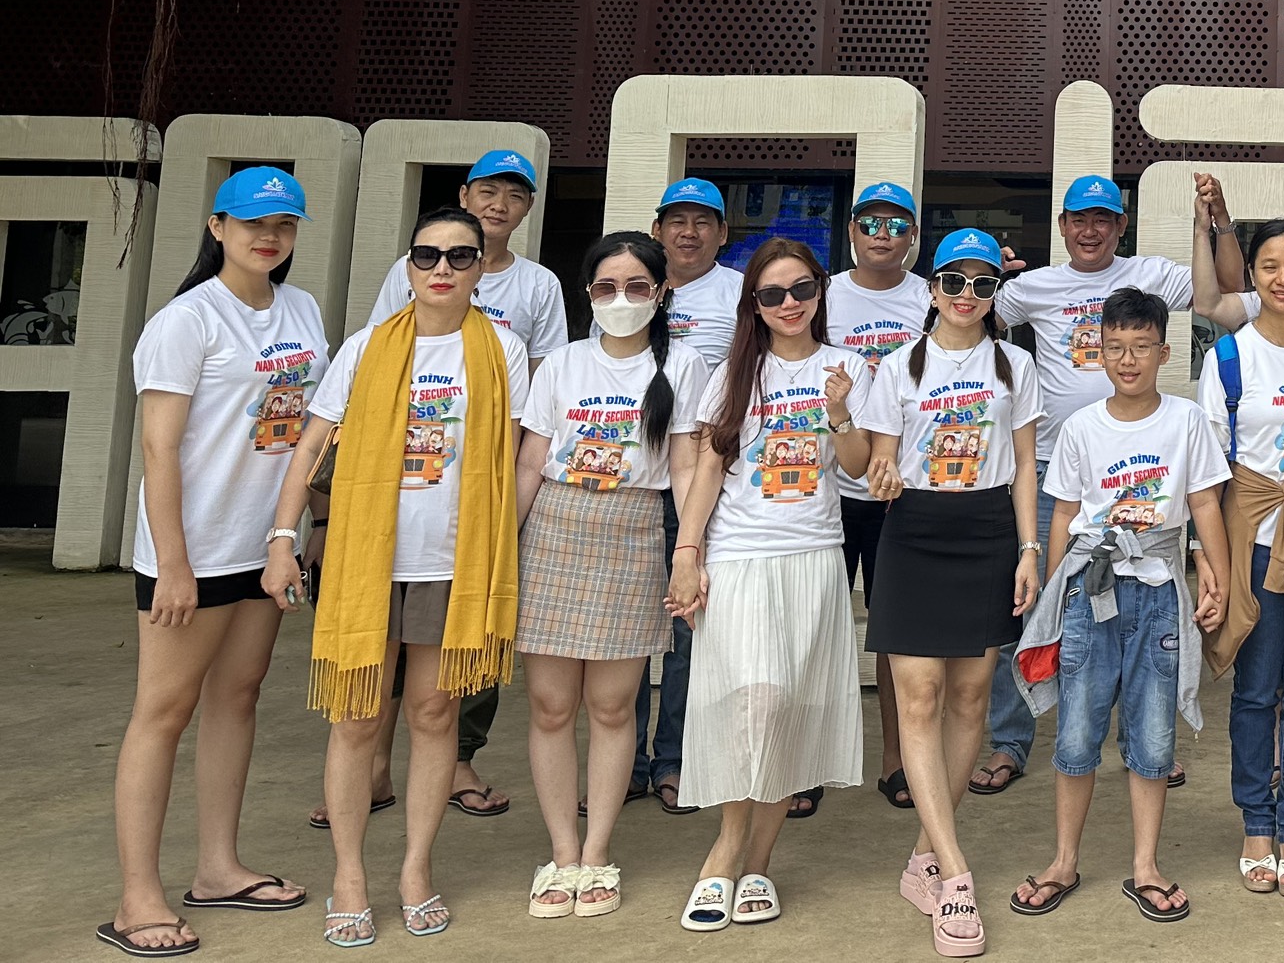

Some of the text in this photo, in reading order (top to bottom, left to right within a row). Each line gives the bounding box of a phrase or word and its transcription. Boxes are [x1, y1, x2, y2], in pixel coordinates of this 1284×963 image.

[853, 323, 873, 334] GIA
[843, 335, 863, 345] NAM
[877, 332, 912, 345] SECURITY
[260, 346, 275, 358] GIA
[255, 359, 275, 372] NAM
[285, 349, 317, 367] SECURITY
[419, 386, 463, 401] SECURITY
[763, 391, 784, 403] GIA
[929, 385, 951, 397] GIA
[579, 397, 603, 407] GIA
[919, 397, 942, 411] NAM
[957, 390, 995, 407] SECURITY
[566, 409, 590, 421] NAM
[1107, 460, 1128, 475] GIA
[1101, 475, 1121, 489] NAM
[1133, 466, 1170, 484] SECURITY
[941, 902, 977, 917] Dior
